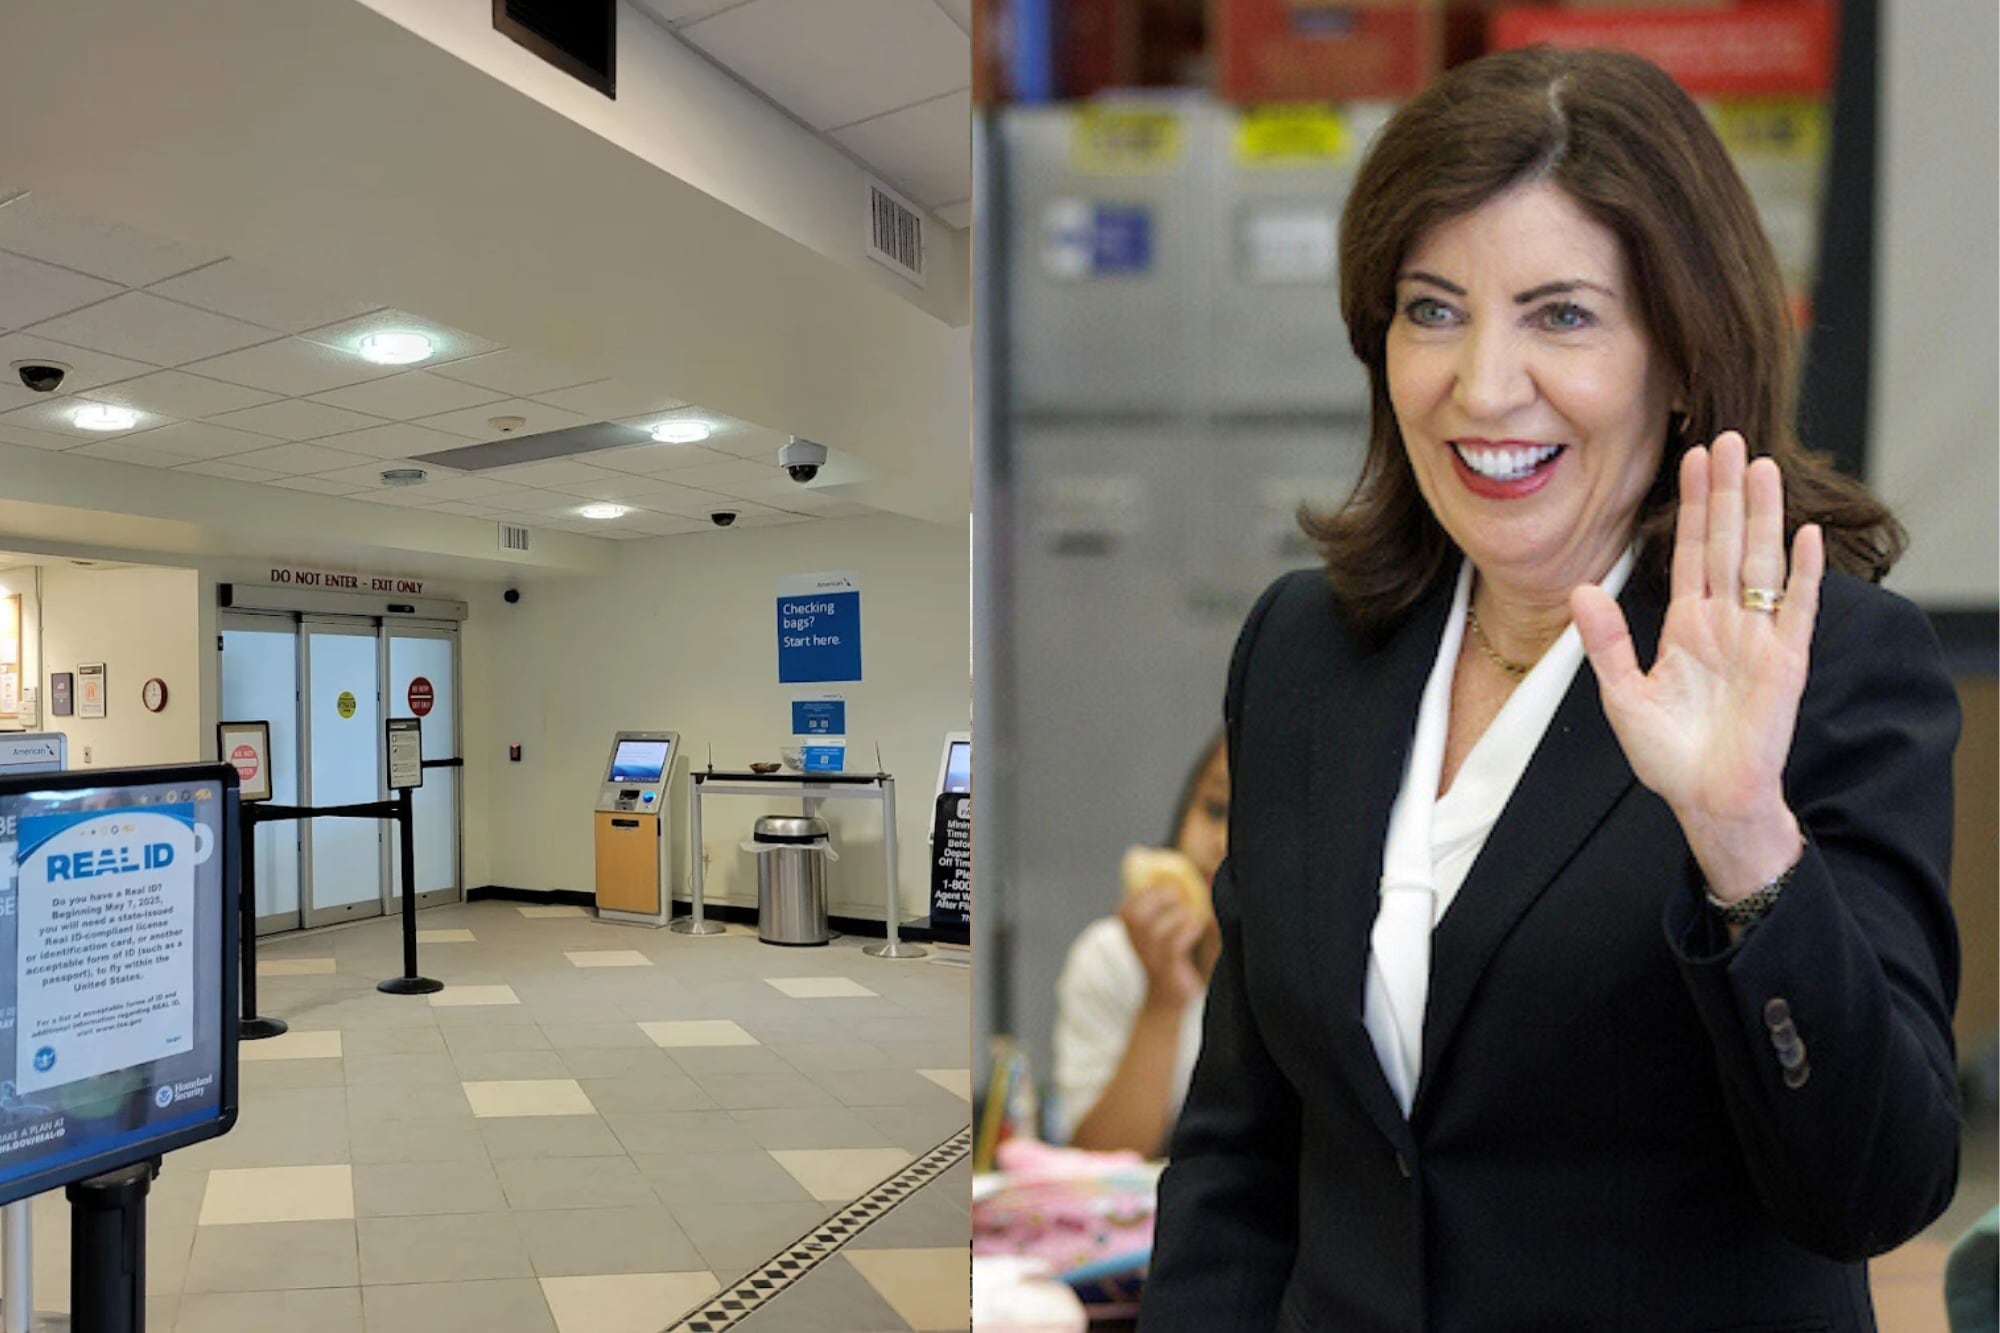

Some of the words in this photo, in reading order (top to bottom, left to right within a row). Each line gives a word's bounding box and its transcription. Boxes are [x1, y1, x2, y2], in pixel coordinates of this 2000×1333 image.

[271, 569, 291, 583] DO
[295, 571, 321, 586] NOT
[325, 574, 358, 589] ENTER
[372, 578, 393, 592] EXIT
[397, 581, 424, 594] ONLY
[783, 602, 835, 616] Checking
[783, 616, 815, 632] bags?
[784, 636, 811, 648] Start
[813, 635, 841, 646] here.
[13, 748, 46, 756] American
[947, 829, 968, 839] Time
[47, 847, 140, 883] REAL
[144, 842, 175, 870] ID
[938, 857, 953, 867] Off
[943, 879, 970, 891] 1-800
[52, 897, 66, 907] Do
[69, 896, 87, 906] you
[90, 891, 113, 900] have
[125, 887, 145, 896] Real
[148, 884, 163, 893] ID?
[935, 890, 960, 901] Agent
[52, 905, 102, 920] Beginning
[105, 902, 125, 914] May
[128, 899, 137, 909] 7,
[139, 895, 164, 907] 2025,
[936, 899, 957, 910] After
[39, 927, 59, 937] you
[61, 921, 79, 931] will
[82, 916, 106, 928] need
[109, 916, 116, 924] a
[118, 906, 175, 922] state-issued
[45, 936, 69, 946] Real
[71, 925, 134, 943] ID-compliant
[136, 919, 169, 931] license
[26, 955, 38, 963] or
[40, 942, 109, 959] identification
[111, 936, 136, 948] card,
[138, 935, 147, 943] or
[150, 928, 184, 940] another
[25, 960, 85, 976] acceptable
[87, 952, 110, 965] form
[113, 949, 122, 959] of
[125, 948, 135, 957] ID
[137, 945, 163, 956] (such
[165, 942, 175, 950] as
[42, 970, 94, 987] passport),
[97, 965, 107, 975] to
[109, 962, 122, 974] fly
[124, 957, 153, 970] within
[155, 953, 170, 963] the
[74, 979, 107, 992] United
[109, 974, 145, 986] States.
[83, 1003, 125, 1017] acceptable
[175, 1074, 213, 1091] Homeland
[174, 1088, 205, 1102] Security
[21, 1127, 28, 1138] A
[30, 1120, 53, 1135] PLAN
[54, 1116, 64, 1128] AT
